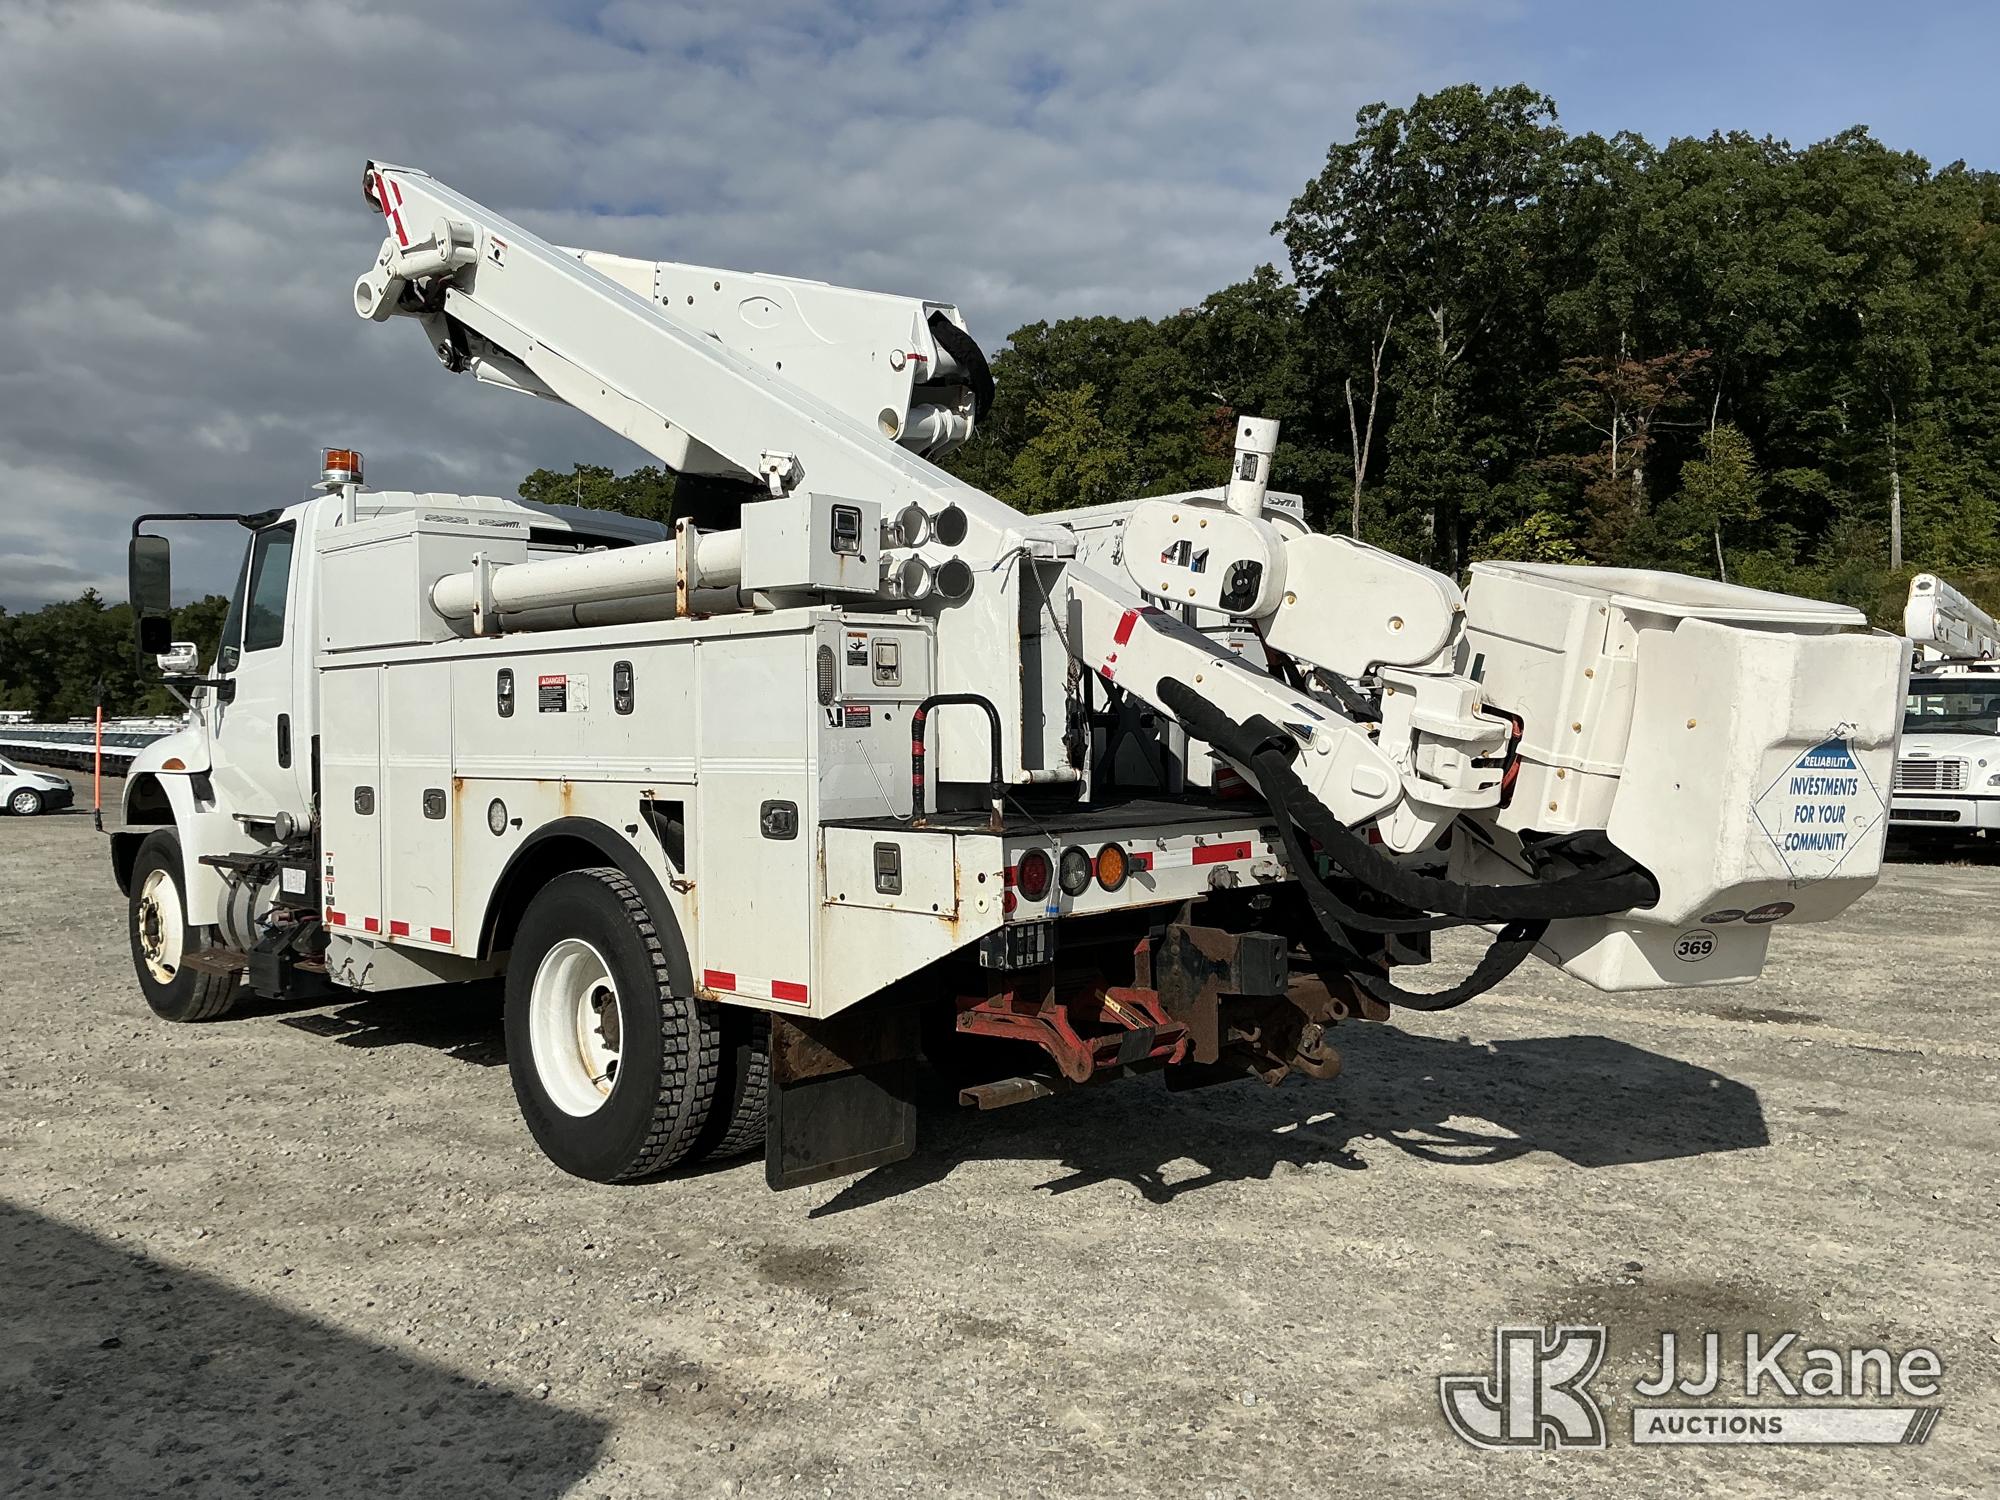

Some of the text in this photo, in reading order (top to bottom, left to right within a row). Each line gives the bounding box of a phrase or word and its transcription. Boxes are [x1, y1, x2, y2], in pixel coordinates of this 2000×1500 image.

[545, 676, 565, 685] DANGER
[1804, 756, 1851, 768] RELIABILITY
[1789, 777, 1858, 796] INVESTMENTS
[1794, 805, 1846, 823] FOR YOUR
[1784, 833, 1848, 851] COMMUNITY
[1678, 940, 1713, 956] 369
